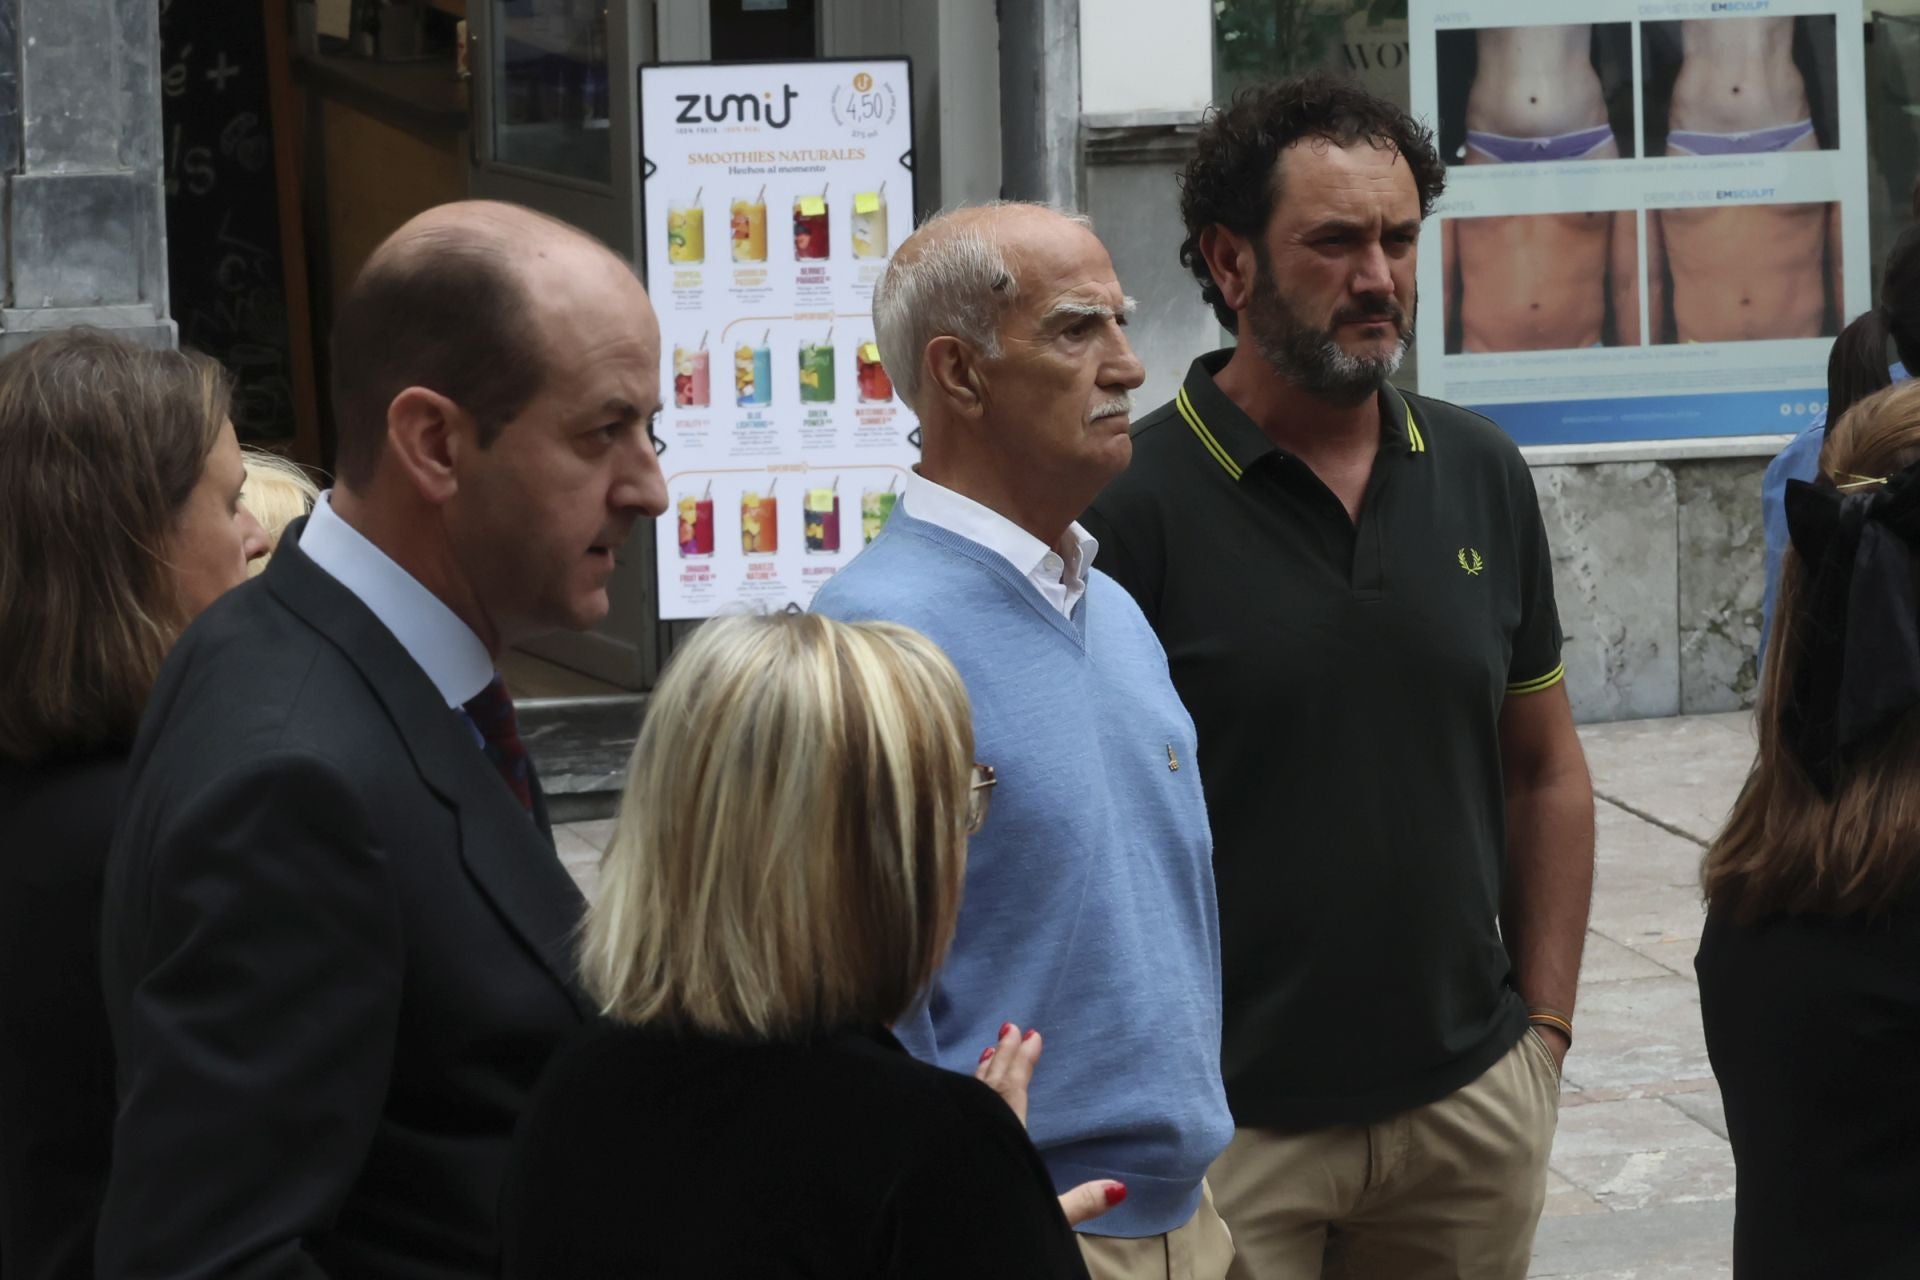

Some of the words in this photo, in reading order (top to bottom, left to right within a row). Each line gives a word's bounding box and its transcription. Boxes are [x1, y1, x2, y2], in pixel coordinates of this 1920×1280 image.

[846, 92, 883, 123] 4,50
[687, 151, 776, 165] SMOOTHIES
[778, 148, 866, 162] NATURALES
[728, 165, 766, 175] Hechos
[768, 165, 777, 174] al
[778, 164, 826, 173] momento
[1716, 188, 1775, 200] EMSCULPT
